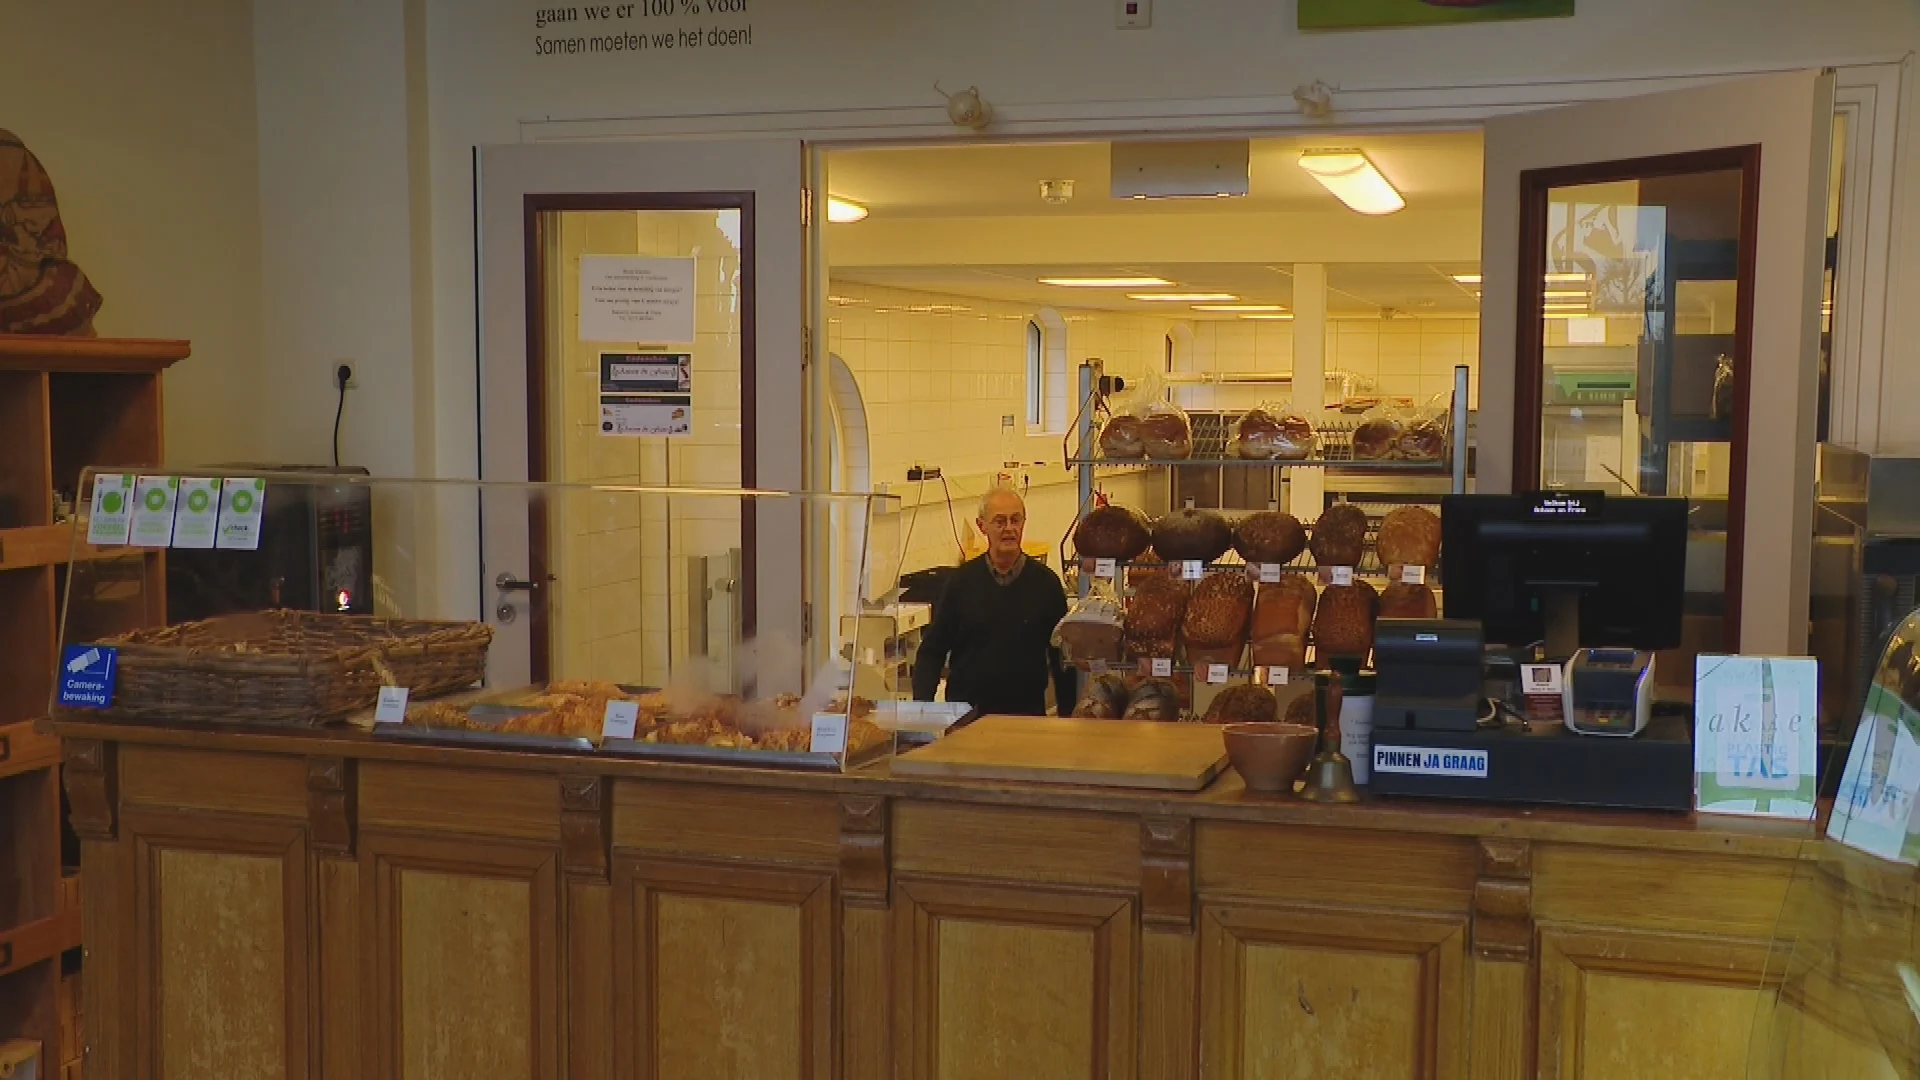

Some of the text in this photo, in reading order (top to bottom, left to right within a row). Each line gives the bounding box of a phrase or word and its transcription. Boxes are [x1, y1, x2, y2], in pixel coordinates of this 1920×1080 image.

[535, 0, 747, 28] gaan we er 100 % voor
[535, 24, 752, 55] Samen moeten we het doen!
[67, 679, 105, 690] Camera-
[63, 691, 106, 704] bewaking
[1377, 751, 1485, 771] PINNEN JA GRAAG
[1728, 755, 1788, 779] TAS
